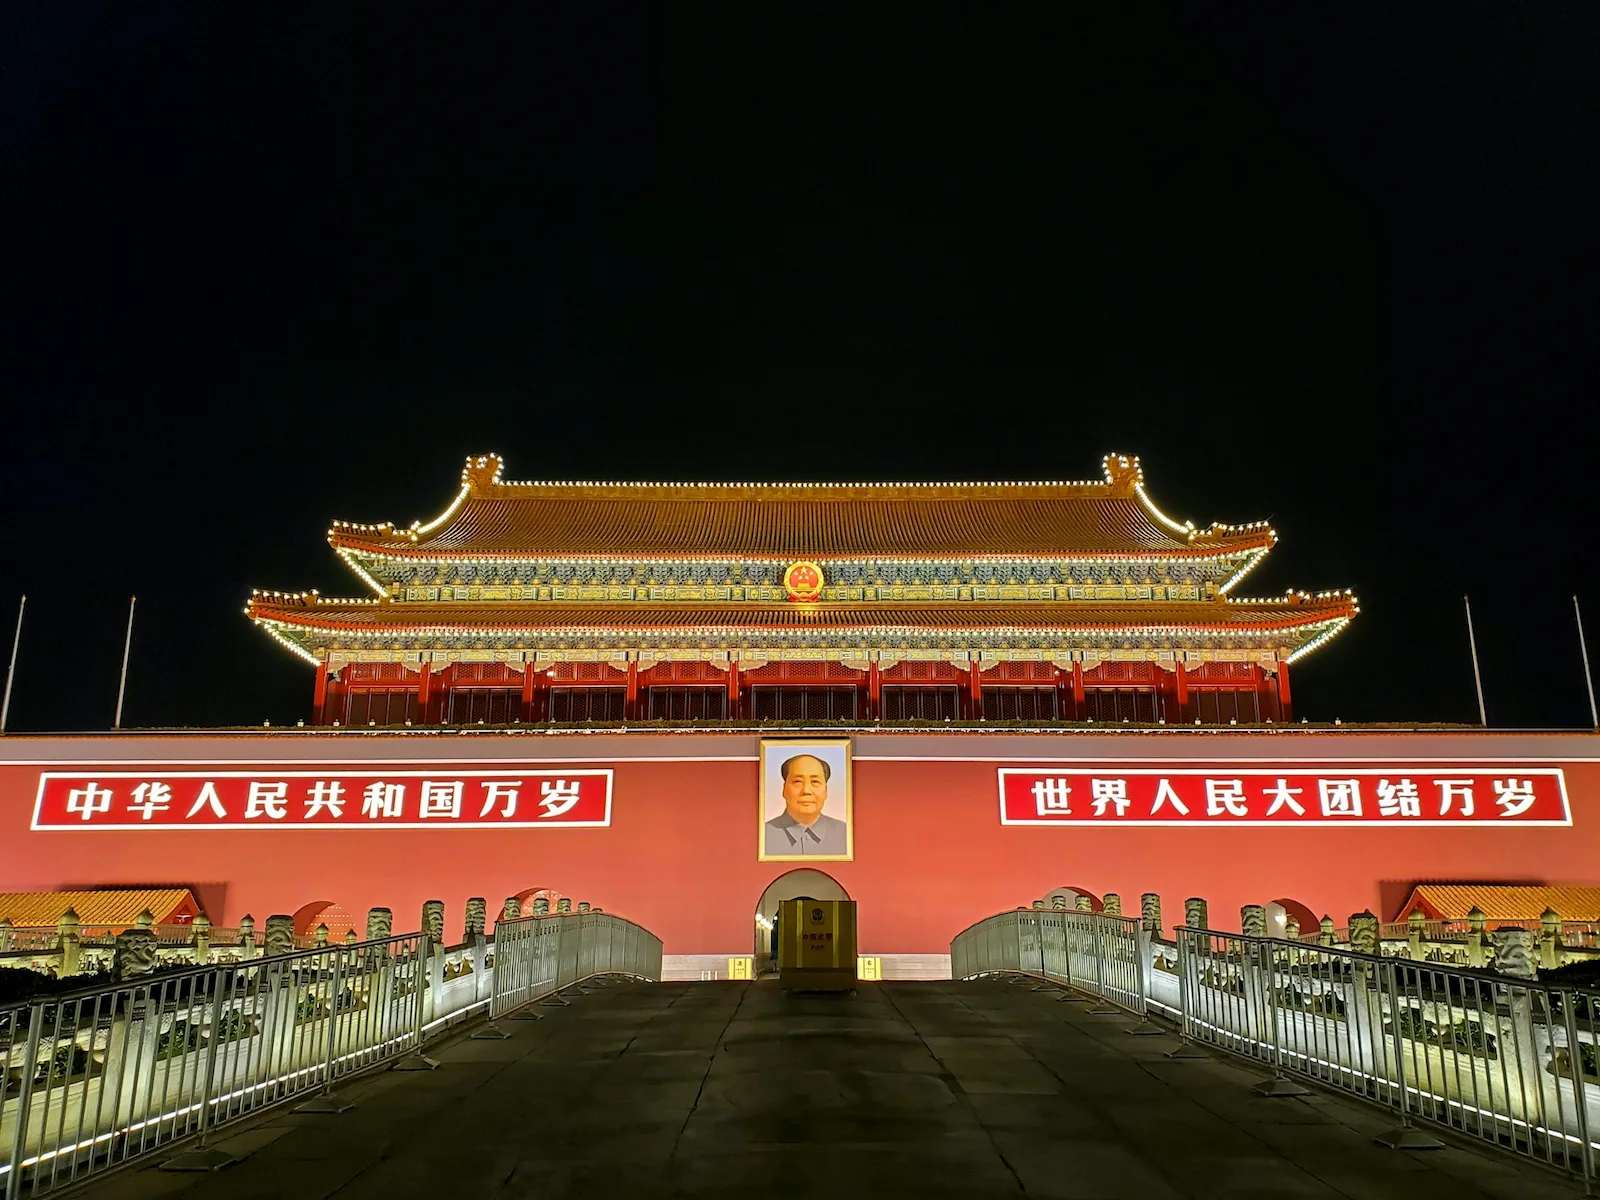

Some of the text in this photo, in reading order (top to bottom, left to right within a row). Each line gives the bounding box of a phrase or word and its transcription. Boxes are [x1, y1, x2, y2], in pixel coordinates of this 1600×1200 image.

[66, 780, 581, 820] 中华人民共和国万岁
[1031, 778, 1537, 817] 世界人民大团结万岁
